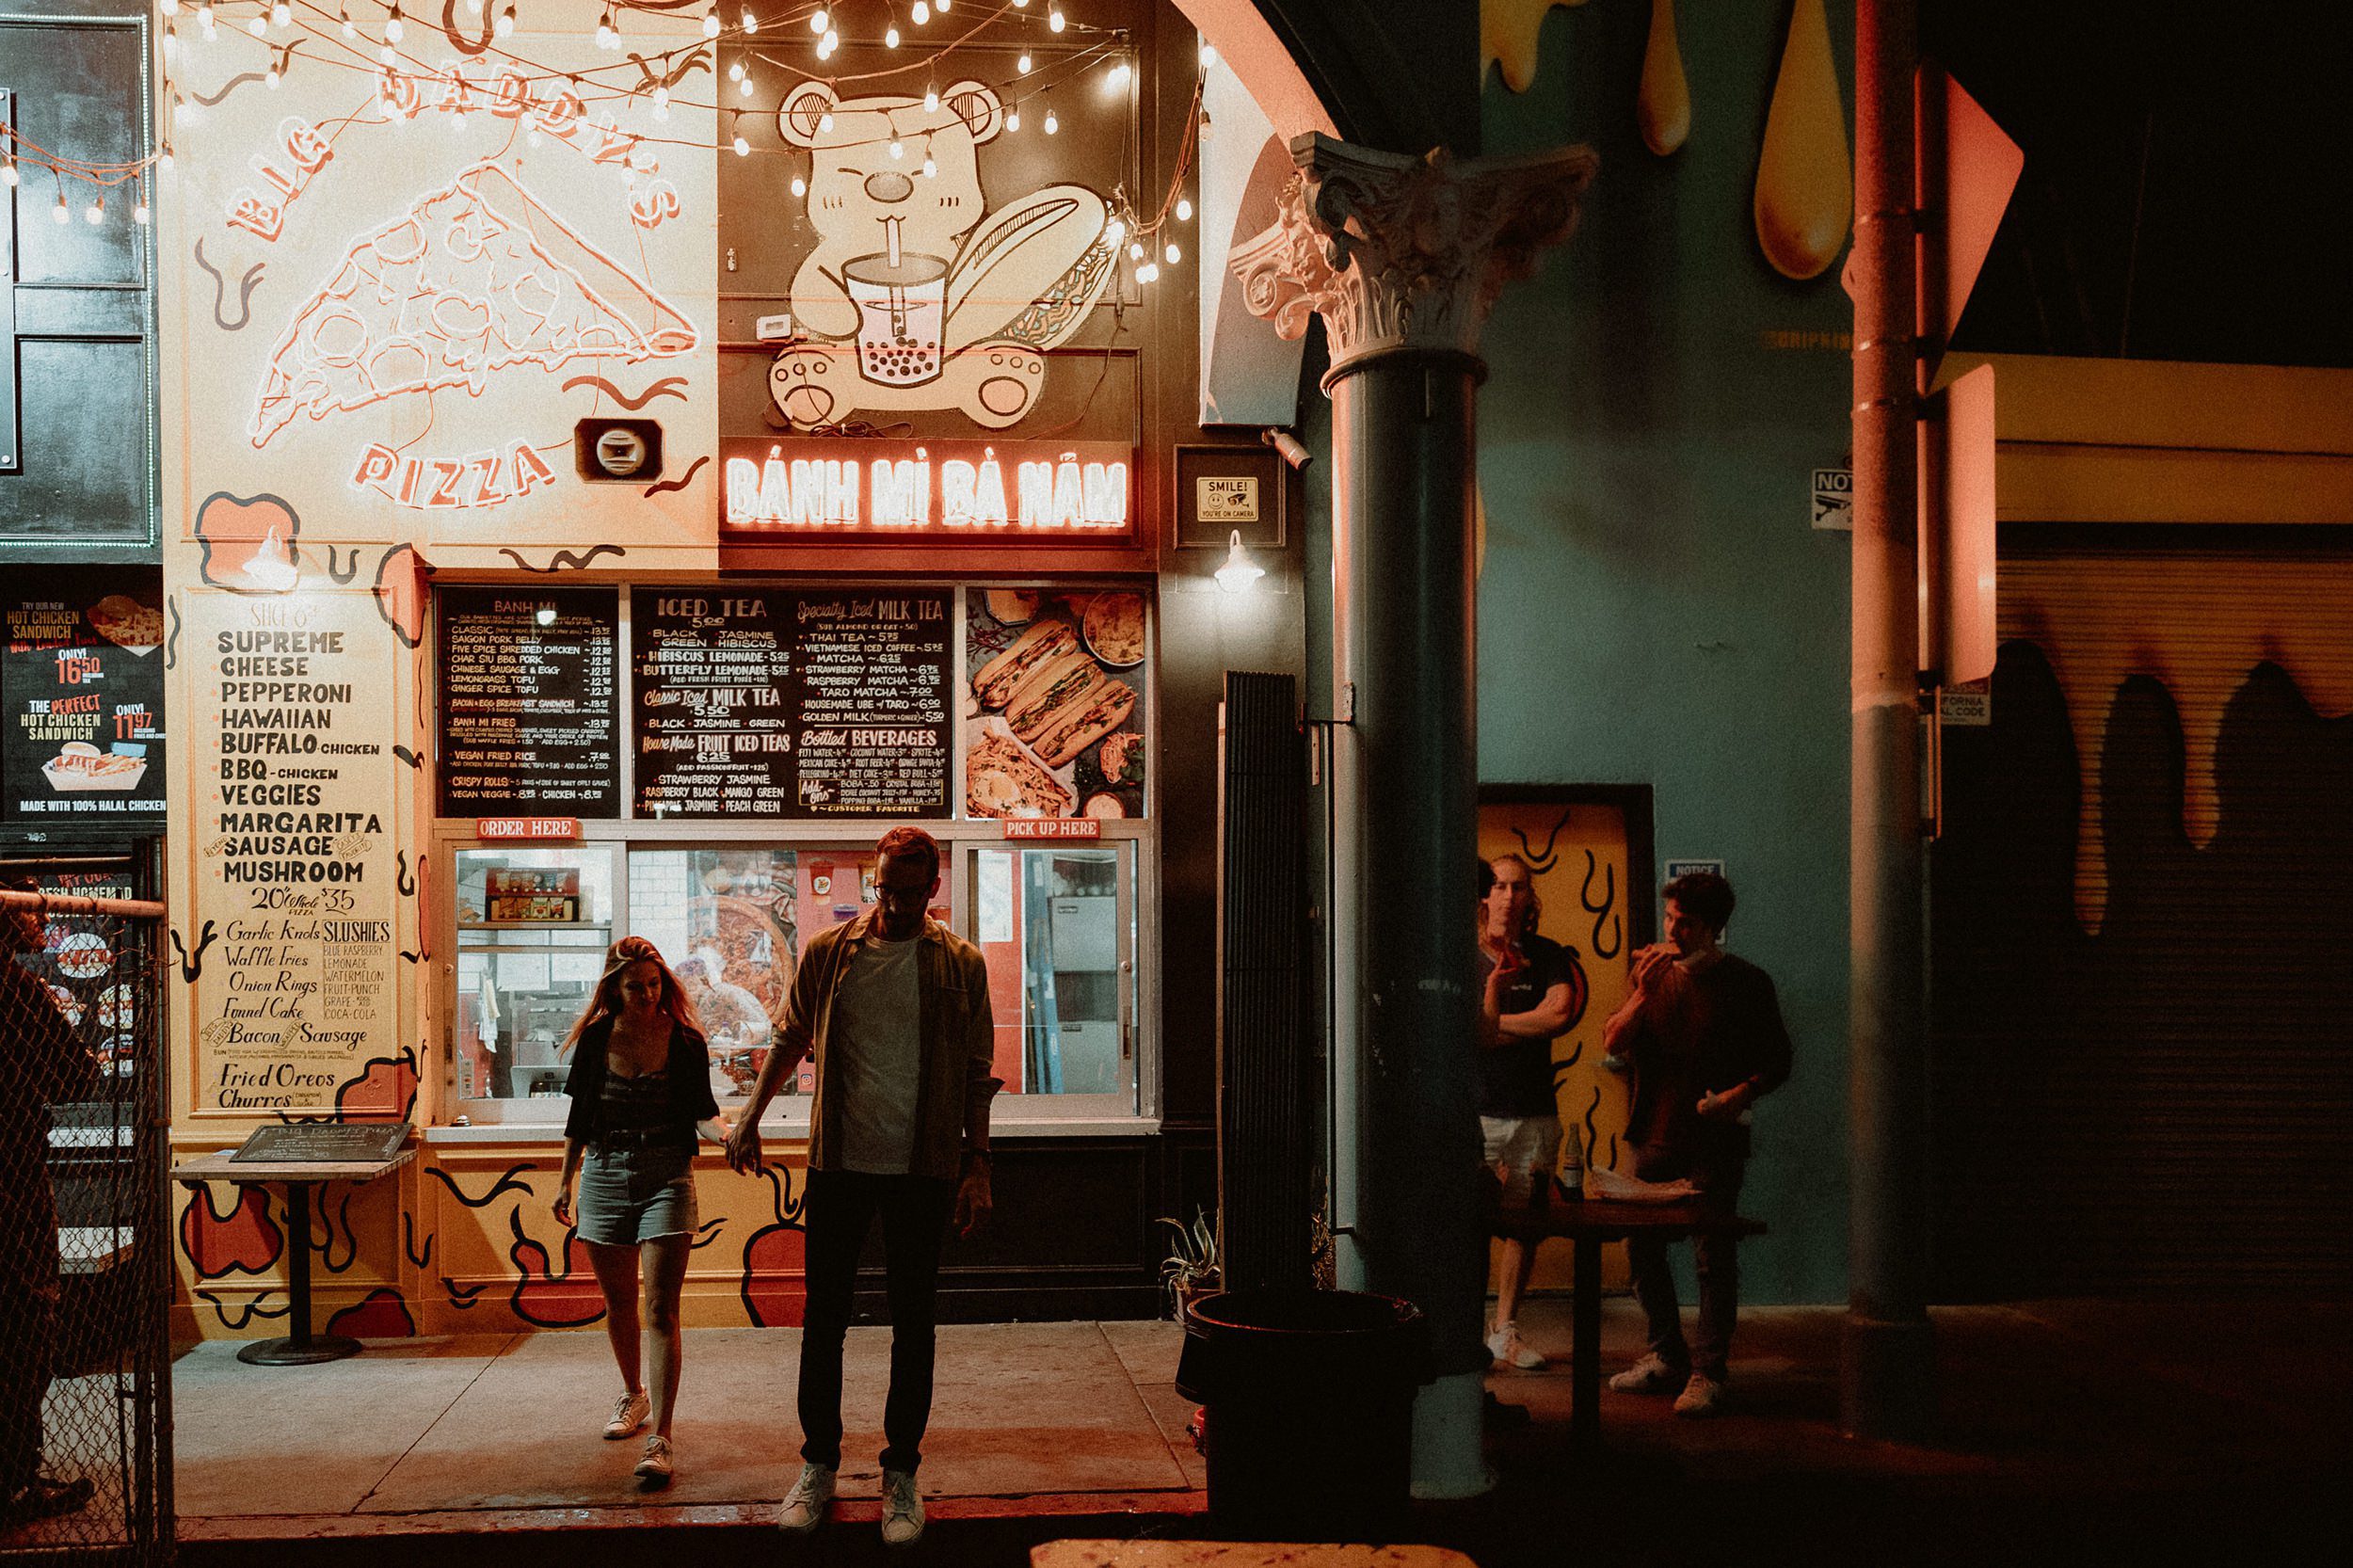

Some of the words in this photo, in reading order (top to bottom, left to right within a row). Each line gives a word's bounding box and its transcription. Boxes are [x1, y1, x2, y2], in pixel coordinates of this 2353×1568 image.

[227, 115, 333, 242] BIG
[350, 437, 555, 510] PIZZA
[1209, 482, 1247, 491] SMILE!
[494, 601, 533, 613] BANH
[658, 599, 708, 616] ICED
[721, 600, 767, 617] TEA
[797, 600, 847, 623] Specialty
[849, 599, 874, 618] Iced
[878, 600, 910, 620] MILK
[918, 600, 943, 620] TEA
[7, 611, 28, 624] HOT
[32, 611, 79, 624] CHICKEN
[12, 625, 71, 638] SANDWICH
[451, 626, 494, 634] CLASSIC
[718, 631, 775, 639] JASMINE
[217, 632, 344, 653] SUPREME
[516, 636, 542, 645] BELLY
[662, 638, 707, 647] GREEN
[718, 640, 777, 648] HIBISCUS
[809, 633, 836, 642] THAI
[840, 633, 865, 642] TEA
[452, 646, 470, 654] FIVE
[500, 646, 542, 654] SHREDDED
[544, 647, 581, 655] CHICKEN
[805, 644, 860, 652] VIETNAMESE
[886, 644, 916, 652] COFFEE
[58, 648, 87, 661] ONLY!
[451, 655, 474, 664] CHAR
[478, 655, 494, 664] SIU
[497, 655, 516, 664] BBQ
[519, 655, 544, 664] PORK
[648, 651, 705, 662] HIBISCUS
[817, 654, 864, 663] MATCHA
[221, 657, 309, 677] CHEESE
[489, 665, 526, 674] SAUSAGE
[537, 666, 561, 675] EGG
[643, 664, 712, 675] BUTTERFLY
[805, 665, 866, 674] STRAWBERRY
[870, 665, 908, 674] MATCHA
[510, 676, 536, 684] TOFU
[807, 677, 860, 685] RASPBERRY
[868, 677, 909, 685] MATCHA
[221, 682, 351, 703] PEPPERONI
[487, 685, 511, 694] SPICE
[517, 685, 539, 694] TOFU
[821, 688, 850, 697] TARO
[854, 688, 898, 697] MATCHA
[644, 690, 680, 706] Classic
[681, 690, 709, 706] Iced
[712, 689, 747, 706] MILK
[752, 688, 780, 706] TEA
[29, 700, 50, 713] THE
[51, 695, 101, 715] PERFECT
[116, 703, 144, 716] ONLY!
[496, 699, 536, 708] BREAKFAST
[805, 700, 854, 709] HOUSEMADE
[856, 700, 874, 709] UBE
[885, 700, 909, 709] TARO
[21, 714, 44, 727] HOT
[48, 714, 101, 727] CHICKEN
[222, 709, 331, 728] HAWAIIAN
[453, 718, 475, 727] BANH
[478, 718, 488, 727] MI
[491, 718, 516, 727] FRIES
[802, 712, 840, 721] GOLDEN
[843, 712, 870, 721] MILK
[648, 719, 685, 728] BLACK
[693, 719, 741, 728] JASMINE
[749, 719, 785, 728] GREEN
[29, 728, 93, 740] SANDWICH
[801, 730, 847, 745] Bottled
[852, 730, 936, 745] BEVERAGES
[221, 733, 317, 754] BUFFALO
[643, 735, 669, 753] House
[669, 736, 696, 752] Made
[697, 735, 731, 752] FRUIT
[735, 735, 759, 752] ICED
[760, 734, 791, 752] TEAS
[455, 751, 484, 760] VEGAN
[488, 752, 512, 760] FRIED
[515, 752, 536, 760] RICE
[221, 759, 266, 779] BBQ
[452, 776, 482, 787] CRISPY
[484, 777, 509, 787] ROLLS
[659, 776, 722, 784] STRAWBERRY
[727, 776, 771, 784] JASMINE
[221, 785, 321, 806] VEGGIES
[542, 790, 576, 799] CHICKEN
[646, 787, 690, 797] RASPBERRY
[693, 787, 718, 797] BLACK
[725, 788, 752, 797] MANGO
[757, 788, 784, 798] GREEN
[21, 801, 46, 811] MADE
[48, 801, 71, 811] WITH
[72, 801, 97, 811] 100%
[99, 801, 127, 810] HALAL
[129, 801, 166, 810] CHICKEN
[685, 800, 718, 812] JASMINE
[726, 801, 751, 812] PEACH
[753, 801, 780, 812] GREEN
[221, 813, 382, 833] MARGARITA
[480, 821, 524, 835] ORDER
[532, 821, 571, 835] HERE
[1007, 823, 1034, 835] PICK
[1039, 823, 1057, 835] UP
[1061, 823, 1096, 835] HERE
[224, 836, 333, 856] SAUSAGE
[225, 861, 363, 882] MUSHROOM
[1676, 865, 1714, 875] NOTICE
[322, 888, 355, 911] $35
[227, 920, 274, 941] Garlic
[324, 921, 391, 942] SLUSHIES
[225, 946, 275, 966] Waffle
[280, 946, 309, 966] Fries
[324, 946, 340, 955] BLUE
[344, 945, 383, 955] RASPBERRY
[324, 958, 367, 969] LEMONADE
[324, 971, 384, 982] WATERMELON
[230, 971, 271, 991] Onion
[275, 970, 317, 999] Rings
[223, 997, 268, 1018] Funnel
[270, 997, 303, 1018] Cake
[227, 1022, 280, 1044] Bacon
[300, 1022, 367, 1051] Sausage
[220, 1064, 273, 1086] Fried
[277, 1064, 335, 1087] Oreos
[219, 1089, 291, 1108] Churros
